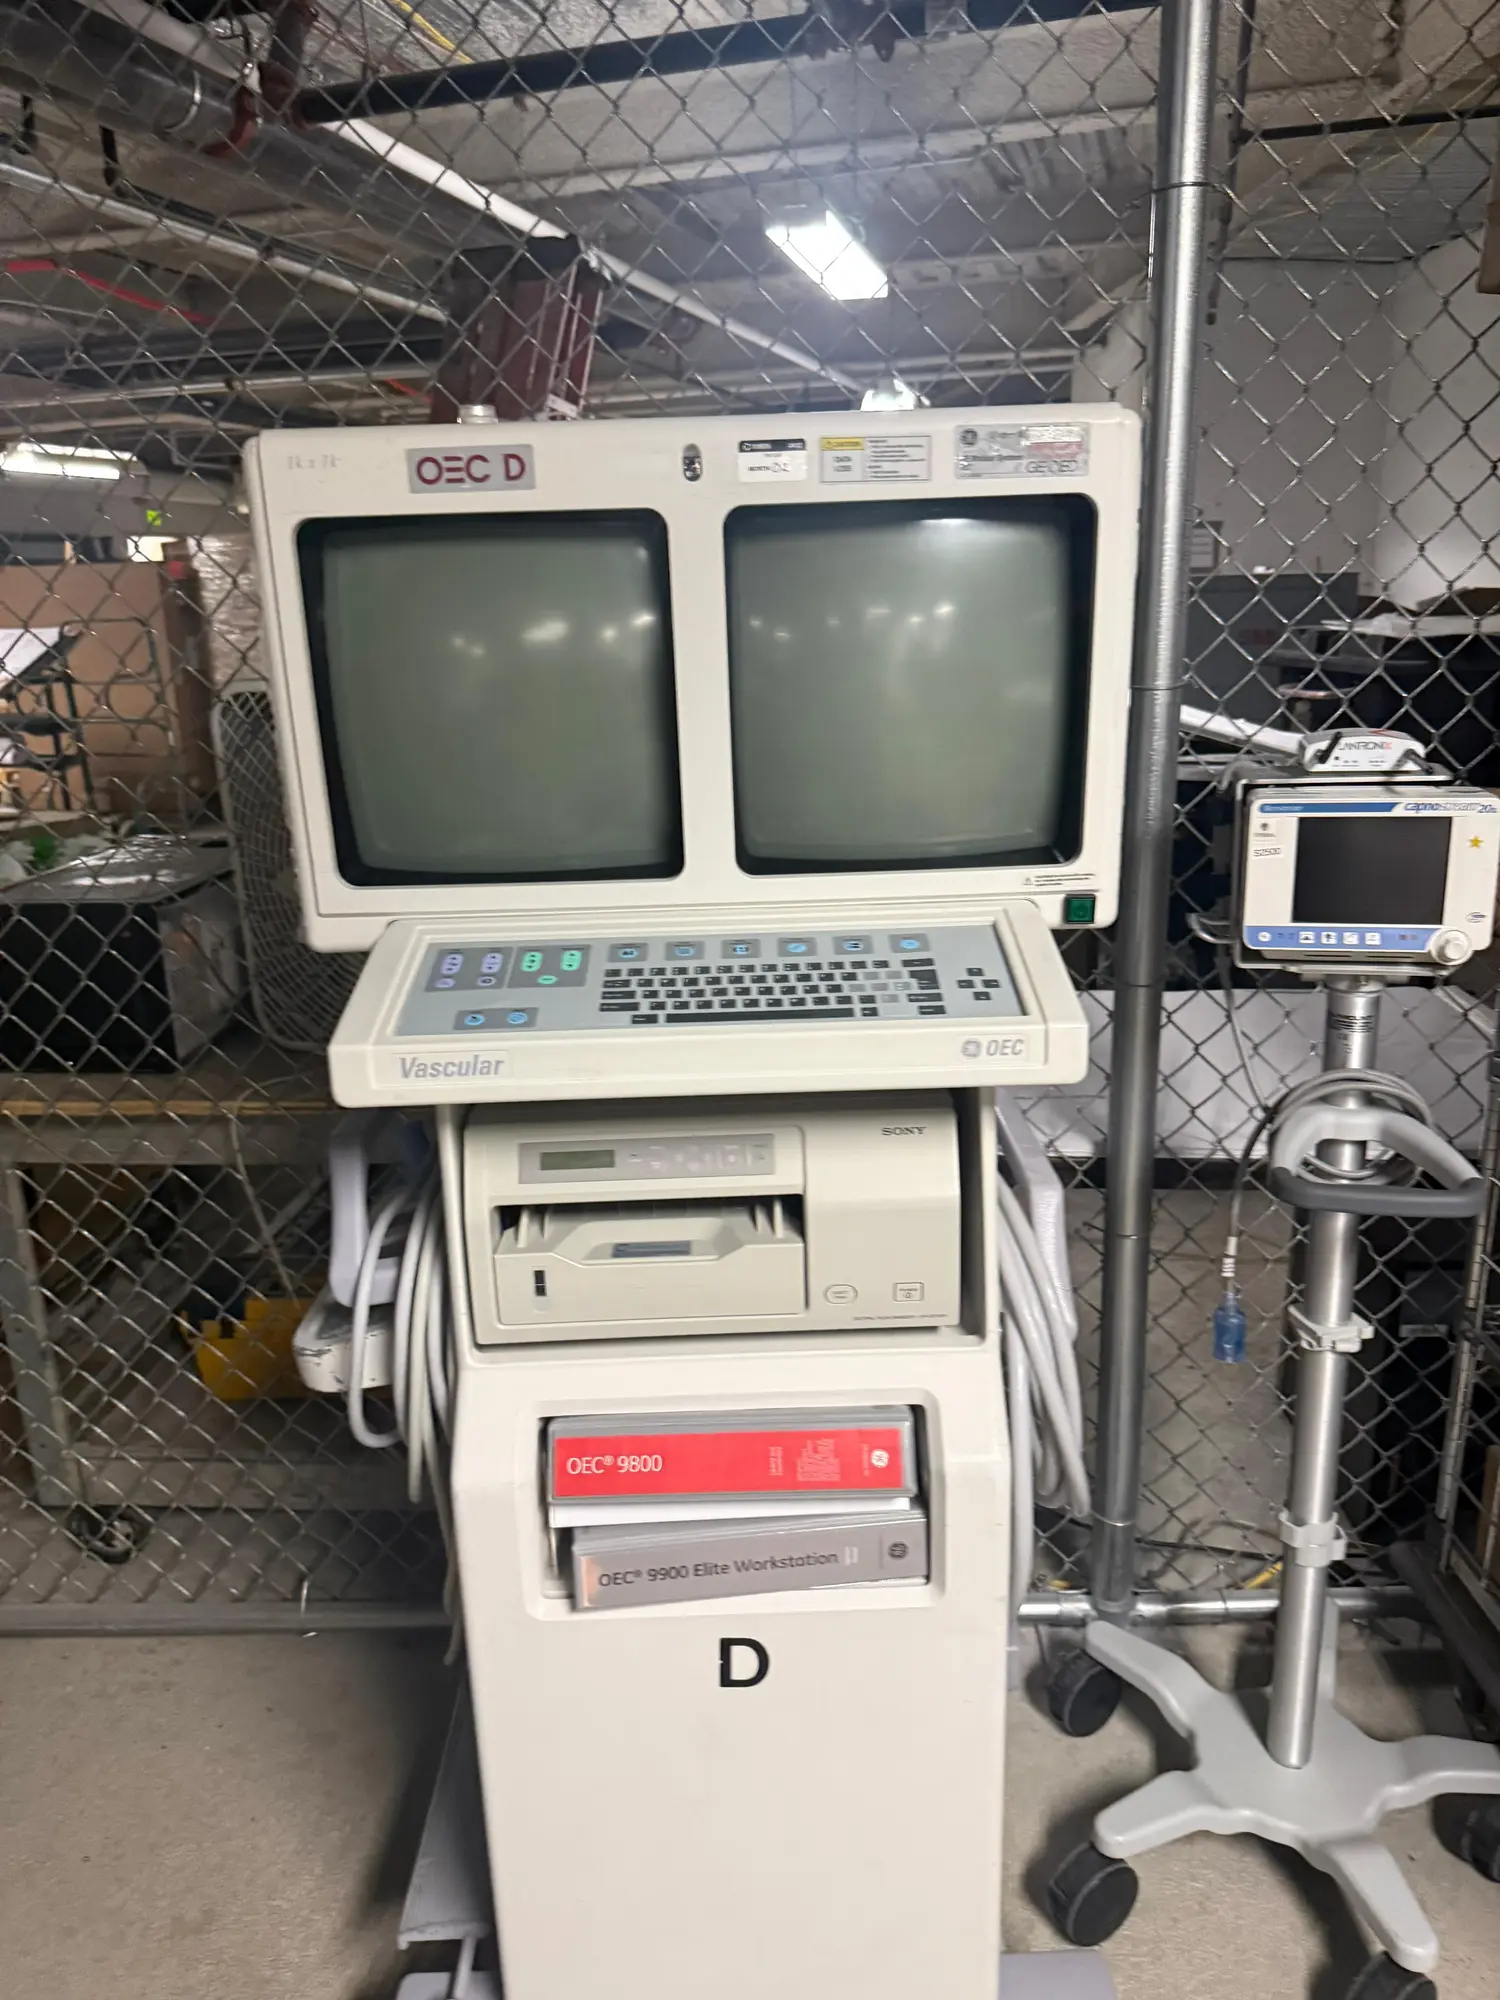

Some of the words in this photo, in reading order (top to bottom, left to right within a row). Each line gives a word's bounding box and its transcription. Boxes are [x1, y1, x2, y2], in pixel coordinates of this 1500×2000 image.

[416, 454, 491, 485] OEC
[503, 453, 526, 481] D
[986, 1039, 1024, 1056] OEC
[399, 1054, 505, 1079] Vascular
[881, 1126, 926, 1136] SONY
[617, 1455, 663, 1473] 9800
[647, 1565, 689, 1581] 9900
[693, 1562, 730, 1577] Elite
[734, 1552, 839, 1573] Workstation
[720, 1637, 769, 1688] D
